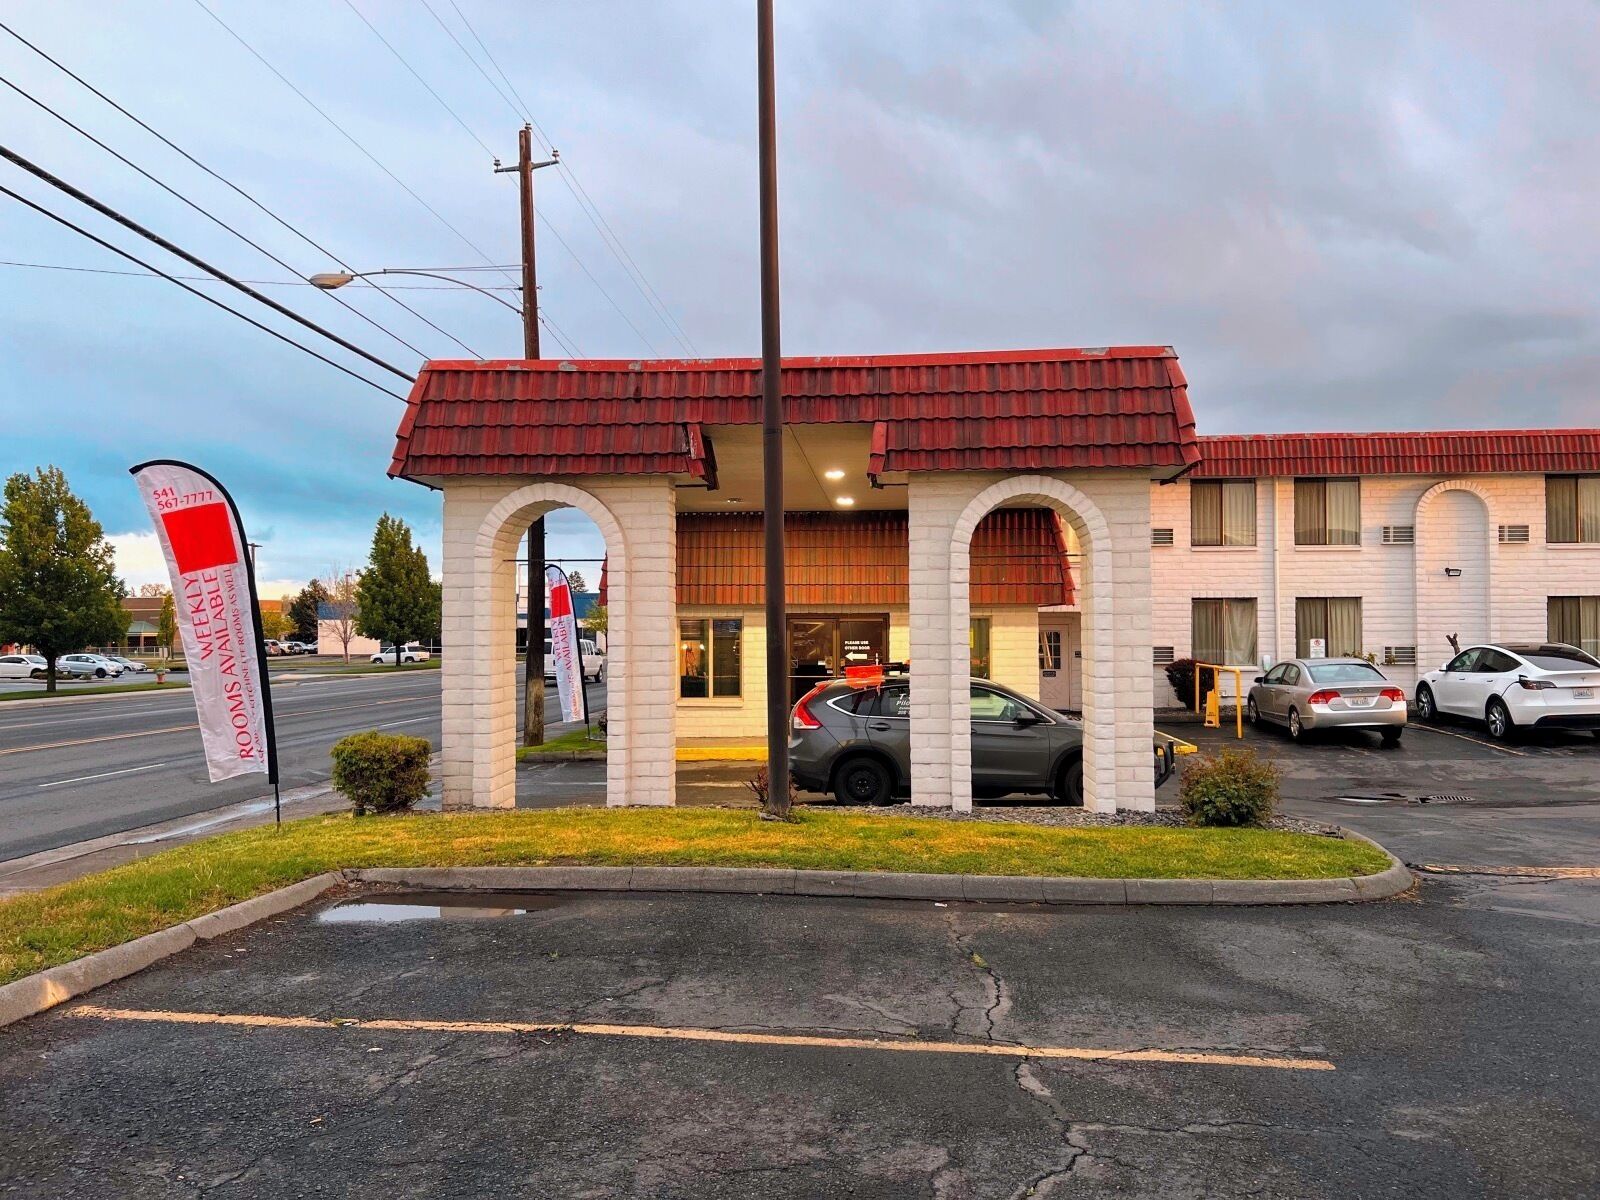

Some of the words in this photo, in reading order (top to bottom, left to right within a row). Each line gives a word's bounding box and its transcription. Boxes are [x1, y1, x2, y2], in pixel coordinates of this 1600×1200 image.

[153, 487, 175, 500] 541
[157, 491, 213, 511] 567-7777
[223, 568, 236, 593] WELL
[183, 576, 214, 661] WEEKLY
[229, 594, 237, 606] AS
[202, 570, 239, 677] AVAILABLE
[232, 608, 245, 645] ROOMS
[558, 618, 573, 671] AVAILABLE
[224, 681, 255, 759] ROOMS
